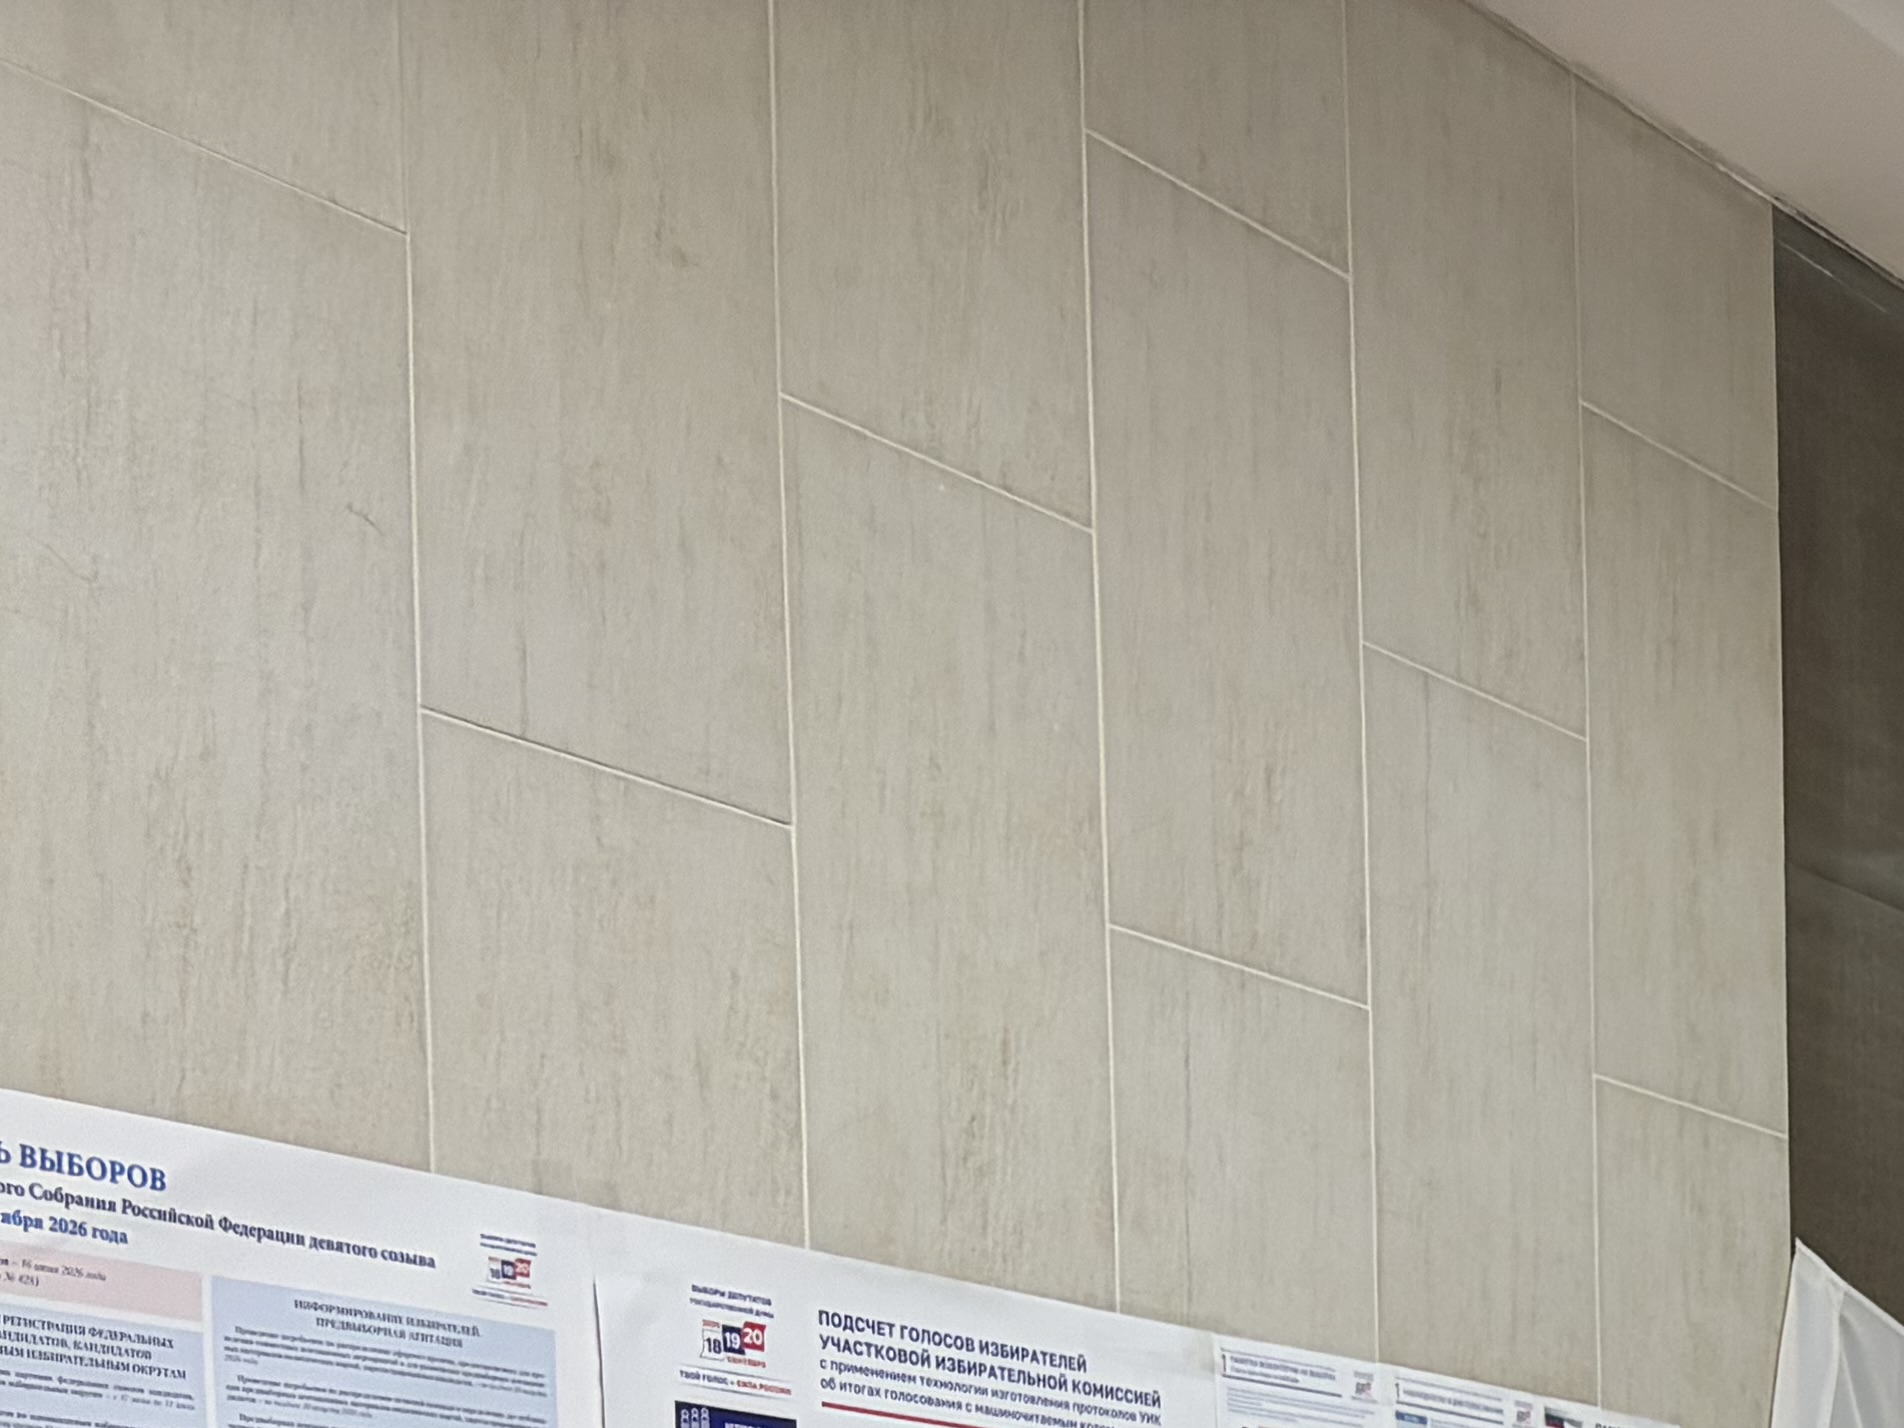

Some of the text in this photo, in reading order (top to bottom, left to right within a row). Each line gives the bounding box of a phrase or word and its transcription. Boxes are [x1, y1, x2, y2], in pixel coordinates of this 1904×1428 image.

[20, 1144, 166, 1191] ВЫБОРОВ
[29, 1183, 116, 1212] Собрания
[122, 1199, 214, 1230] Российской
[219, 1217, 305, 1246] Федерации
[308, 1236, 378, 1259] девятого
[380, 1249, 436, 1269] созыва
[48, 1215, 88, 1237] 2026
[91, 1226, 129, 1245] года
[705, 1320, 764, 1355] 18 19 20
[819, 1310, 1086, 1373] ПОДСЧЕТ ГОЛОСОВ ИЗБИРАТЕЛЕЙ
[819, 1358, 1162, 1426] с применением технологии изготовления протоколов УИК
[819, 1376, 837, 1391] об
[839, 1381, 882, 1398] итогах
[884, 1388, 963, 1411] голосования
[964, 1402, 973, 1414] с
[820, 1334, 1160, 1408] УЧАСТКОВОЙ ИЗБИРАТЕЛЬНОЙ КОМИССИЕЙ
